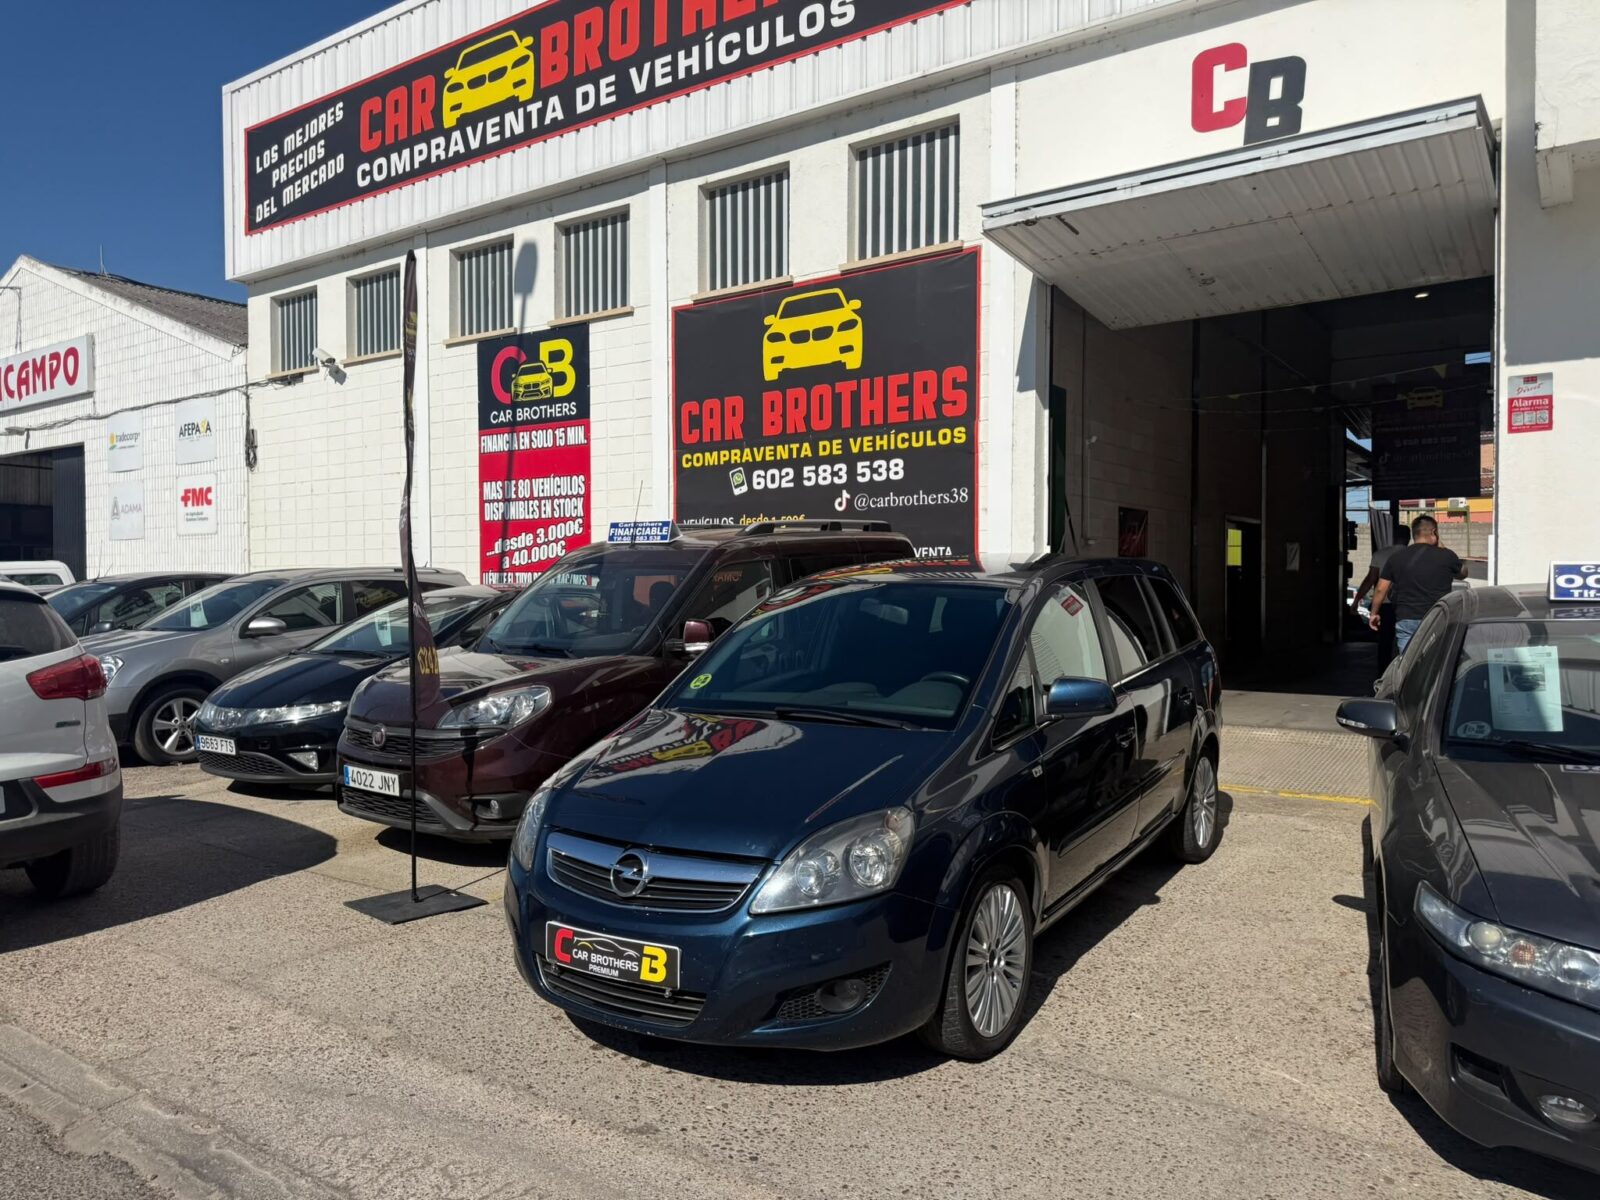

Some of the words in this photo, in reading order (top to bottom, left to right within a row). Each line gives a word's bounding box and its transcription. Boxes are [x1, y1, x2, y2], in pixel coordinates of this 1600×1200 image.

[360, 74, 436, 153] CAR
[540, 0, 778, 89] BROTH
[356, 95, 564, 187] COMPRAVENTA
[575, 74, 616, 112] DE
[629, 0, 856, 94] VEHÍCULOS
[256, 144, 279, 174] LOS
[284, 101, 344, 152] MEJORES
[272, 139, 326, 188] PRECIOS
[256, 196, 278, 223] DEL
[283, 153, 345, 207] MERCADO
[490, 409, 513, 424] CAR
[516, 402, 577, 421] BROTHERS
[680, 395, 744, 444] CAR
[762, 365, 968, 437] BROTHERS
[1512, 398, 1549, 408] Alarma
[480, 432, 518, 453] FINANCIA
[519, 431, 529, 451] EN
[531, 428, 553, 449] SOLO
[555, 427, 565, 446] 15
[566, 425, 587, 445] MIN.
[681, 441, 812, 469] COMPRAVENTA
[818, 438, 843, 456] DE
[849, 426, 967, 454] VEHÍCULOS
[483, 481, 503, 500] MAS
[505, 480, 516, 499] DE
[518, 479, 530, 498] 80
[532, 474, 585, 497] VEHÍCULOS
[752, 467, 795, 490] 602
[802, 463, 848, 487] 583
[856, 458, 905, 483] 538
[181, 487, 212, 507] FMC
[484, 500, 539, 521] DISPONIBLES
[541, 499, 551, 519] EN
[553, 497, 584, 518] STOCK
[854, 487, 969, 511] @carbrothers38
[536, 518, 583, 544] 3.000€
[609, 526, 669, 536] FINANCIABLE
[502, 556, 509, 569] a
[512, 540, 566, 566] 40.000€
[913, 546, 952, 558] VENTA
[1580, 565, 1600, 573] C
[351, 769, 375, 789] 4022
[378, 774, 396, 793] JNY
[572, 948, 589, 961] CAR
[590, 953, 639, 972] BROTHERS
[588, 963, 619, 977] PREMIUM
